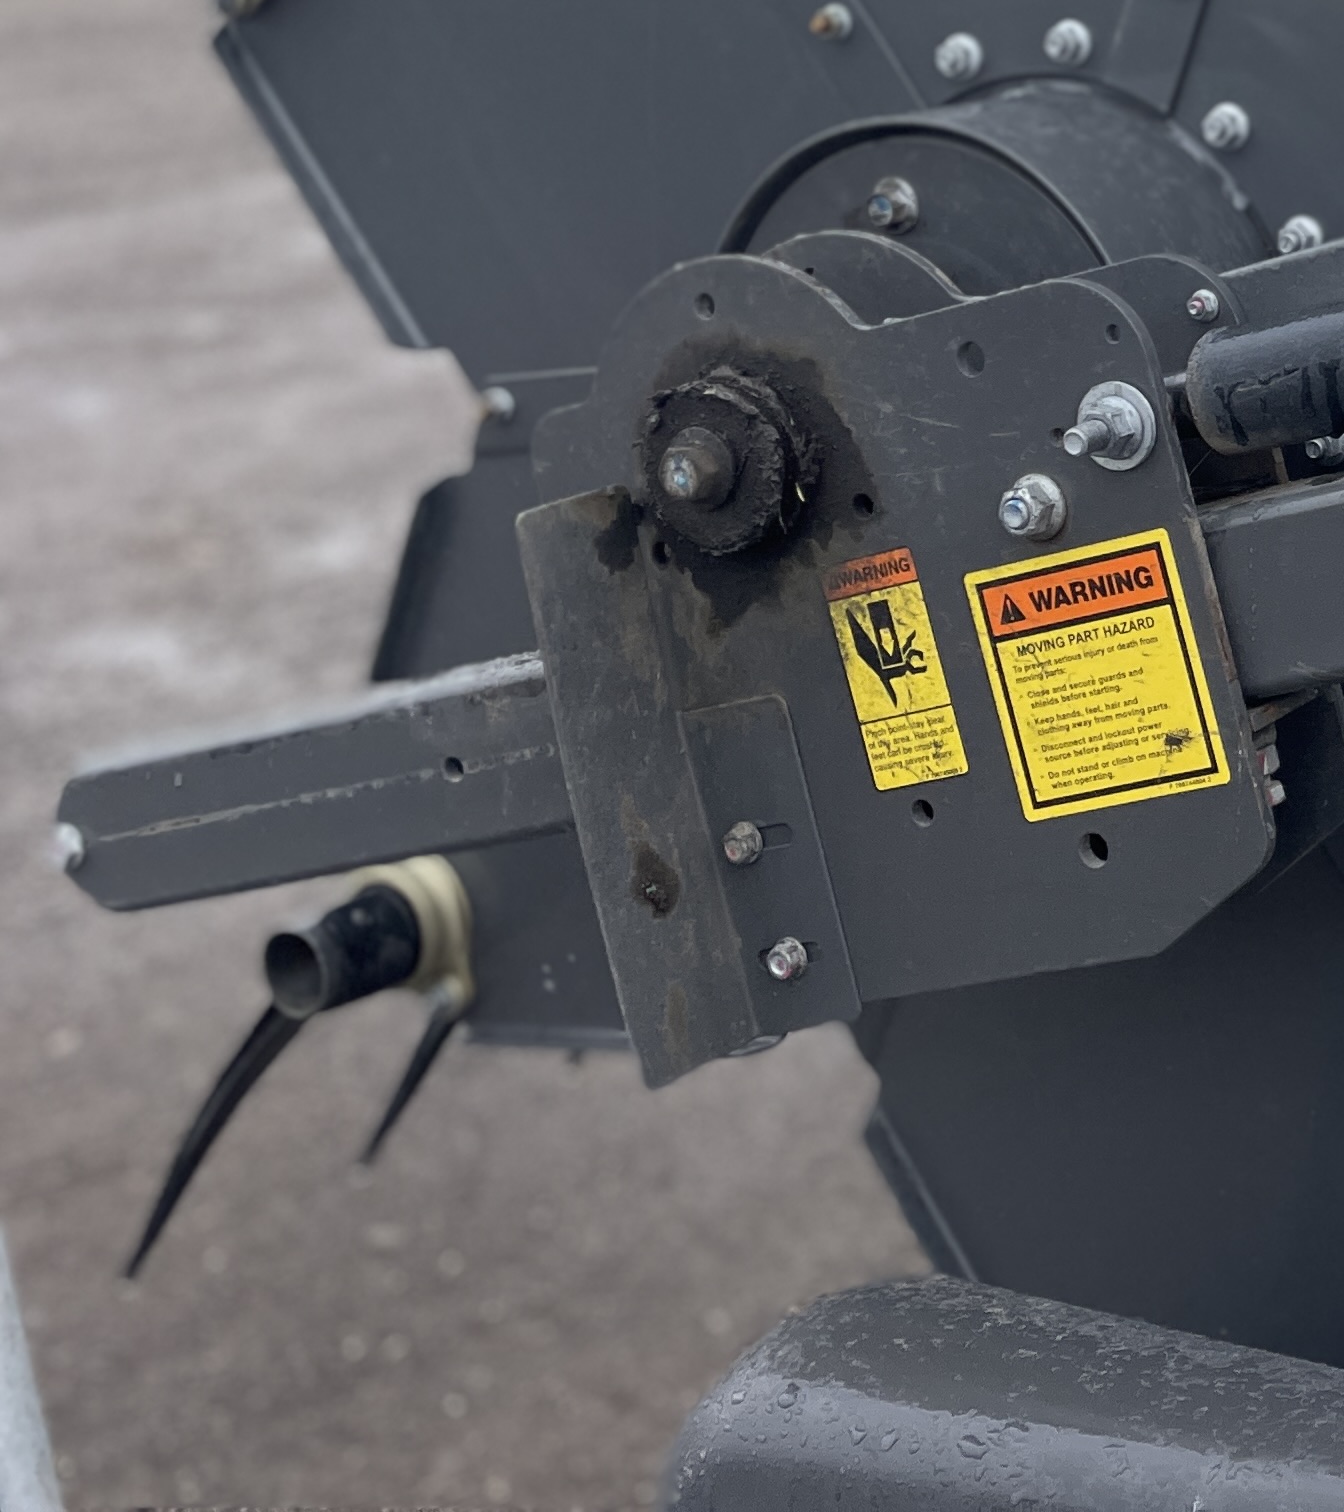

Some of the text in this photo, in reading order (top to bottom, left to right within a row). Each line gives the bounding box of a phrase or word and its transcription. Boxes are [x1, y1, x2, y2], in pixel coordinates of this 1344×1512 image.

[838, 557, 910, 588] WARNING
[1029, 566, 1153, 611] WARNING
[1016, 616, 1154, 656] MOVING PART HAZARD
[1012, 636, 1158, 673] To prevent serious injury or death from
[1015, 671, 1044, 684] moving
[1027, 666, 1143, 698] Close and secure guards and
[1030, 697, 1059, 709] shields
[1060, 692, 1086, 702] before
[1033, 716, 1054, 725] Keep
[1104, 701, 1120, 710] hair
[1123, 696, 1138, 707] and
[1037, 724, 1070, 736] clothing
[1071, 719, 1092, 728] away
[1093, 715, 1113, 723] from
[1115, 707, 1145, 719] moving
[1041, 722, 1162, 752] Disconnect and lockout power
[1044, 752, 1072, 763] source
[1073, 746, 1099, 757] before
[1102, 738, 1139, 751] adjusting
[1047, 771, 1060, 779] Do
[1061, 767, 1075, 776] not
[1076, 762, 1099, 773] stand
[1111, 755, 1134, 766] climb
[1051, 780, 1072, 789] when
